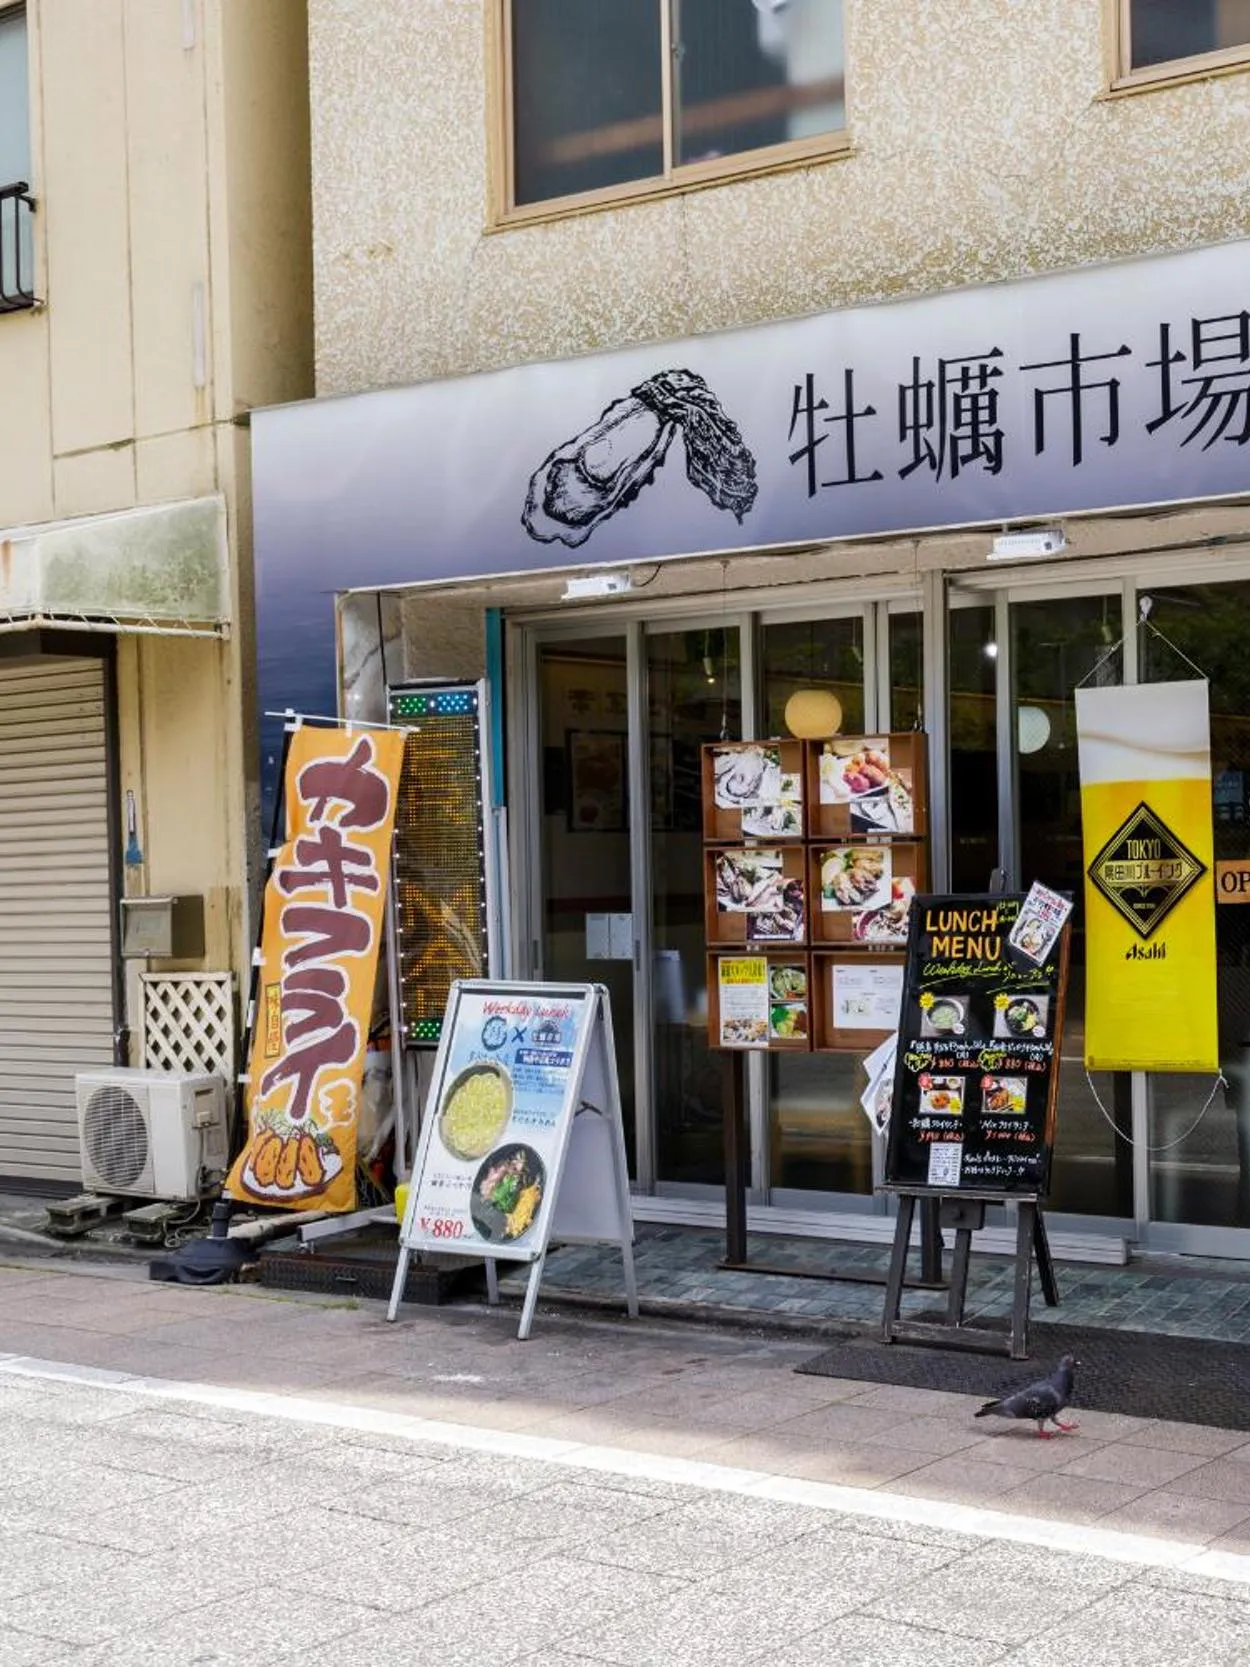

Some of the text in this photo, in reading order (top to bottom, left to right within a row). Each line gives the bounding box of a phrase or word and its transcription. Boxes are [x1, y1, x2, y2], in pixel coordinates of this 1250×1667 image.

[1126, 838, 1161, 859] TOKYO
[259, 735, 390, 1122] カキフライ
[926, 909, 998, 933] LUNCH
[931, 936, 1001, 961] MENU
[1126, 941, 1166, 961] Asahi
[419, 1216, 465, 1240] ¥880
